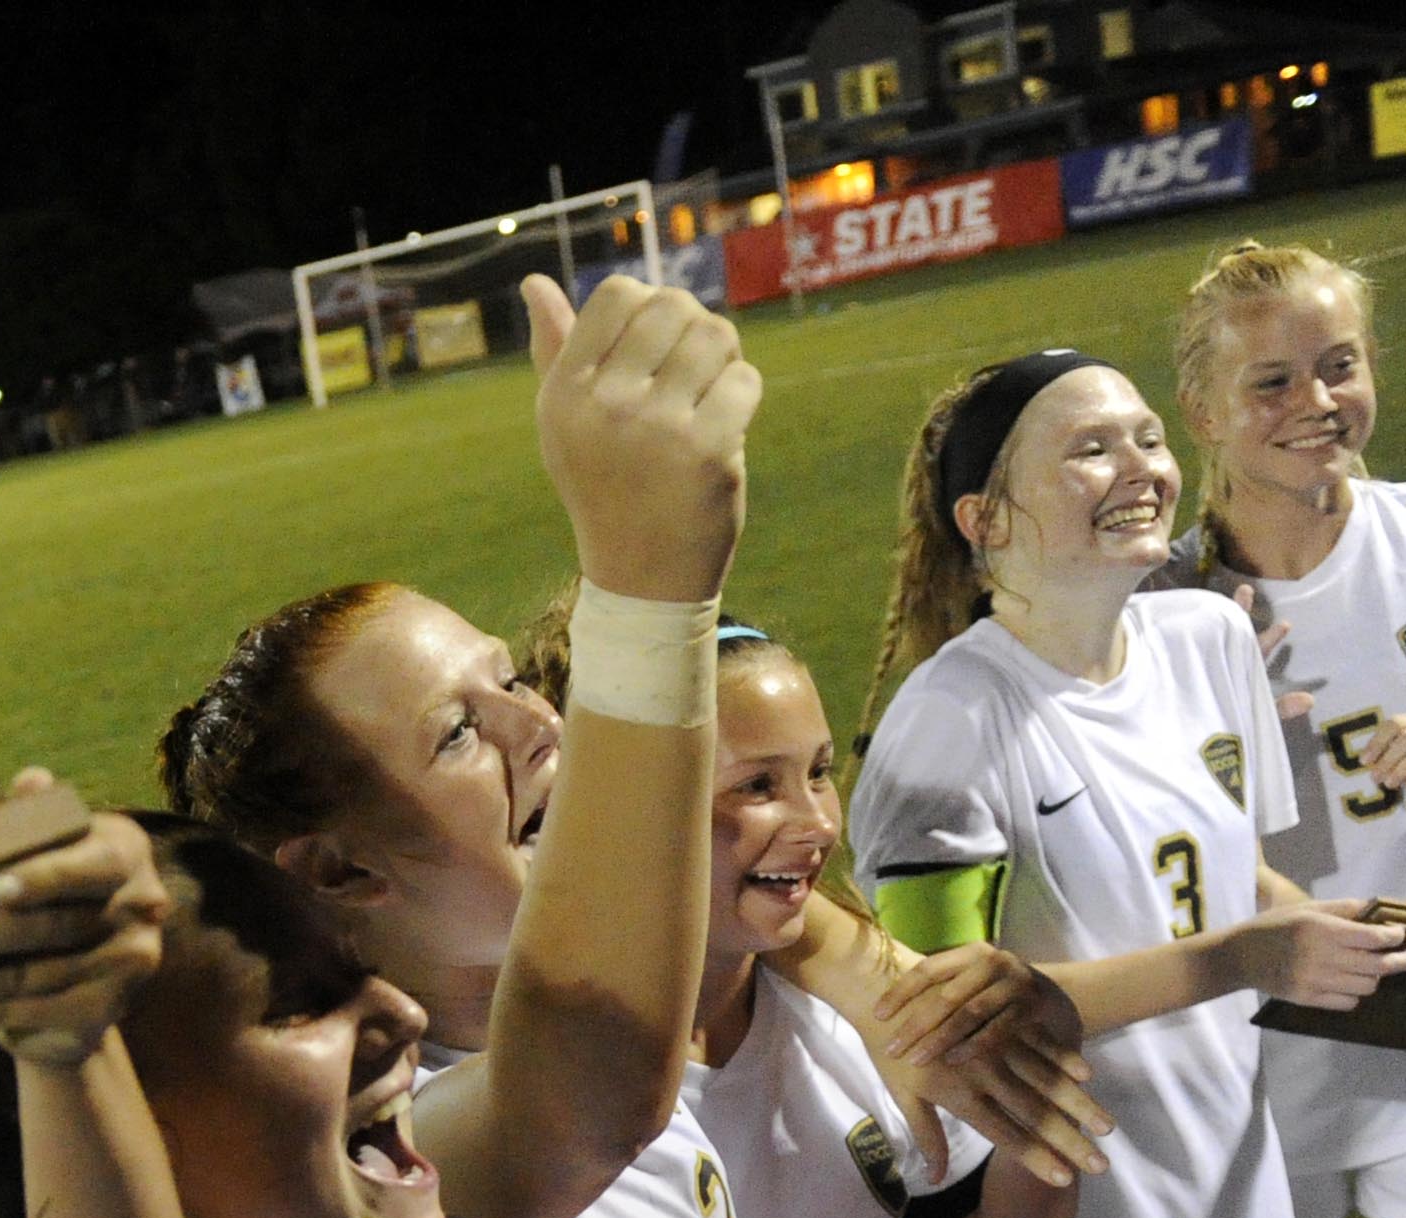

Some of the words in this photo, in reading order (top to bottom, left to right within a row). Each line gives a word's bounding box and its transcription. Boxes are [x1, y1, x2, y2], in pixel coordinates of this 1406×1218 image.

[1094, 127, 1223, 200] HSC
[833, 179, 994, 258] STATE
[1152, 829, 1206, 939] 3
